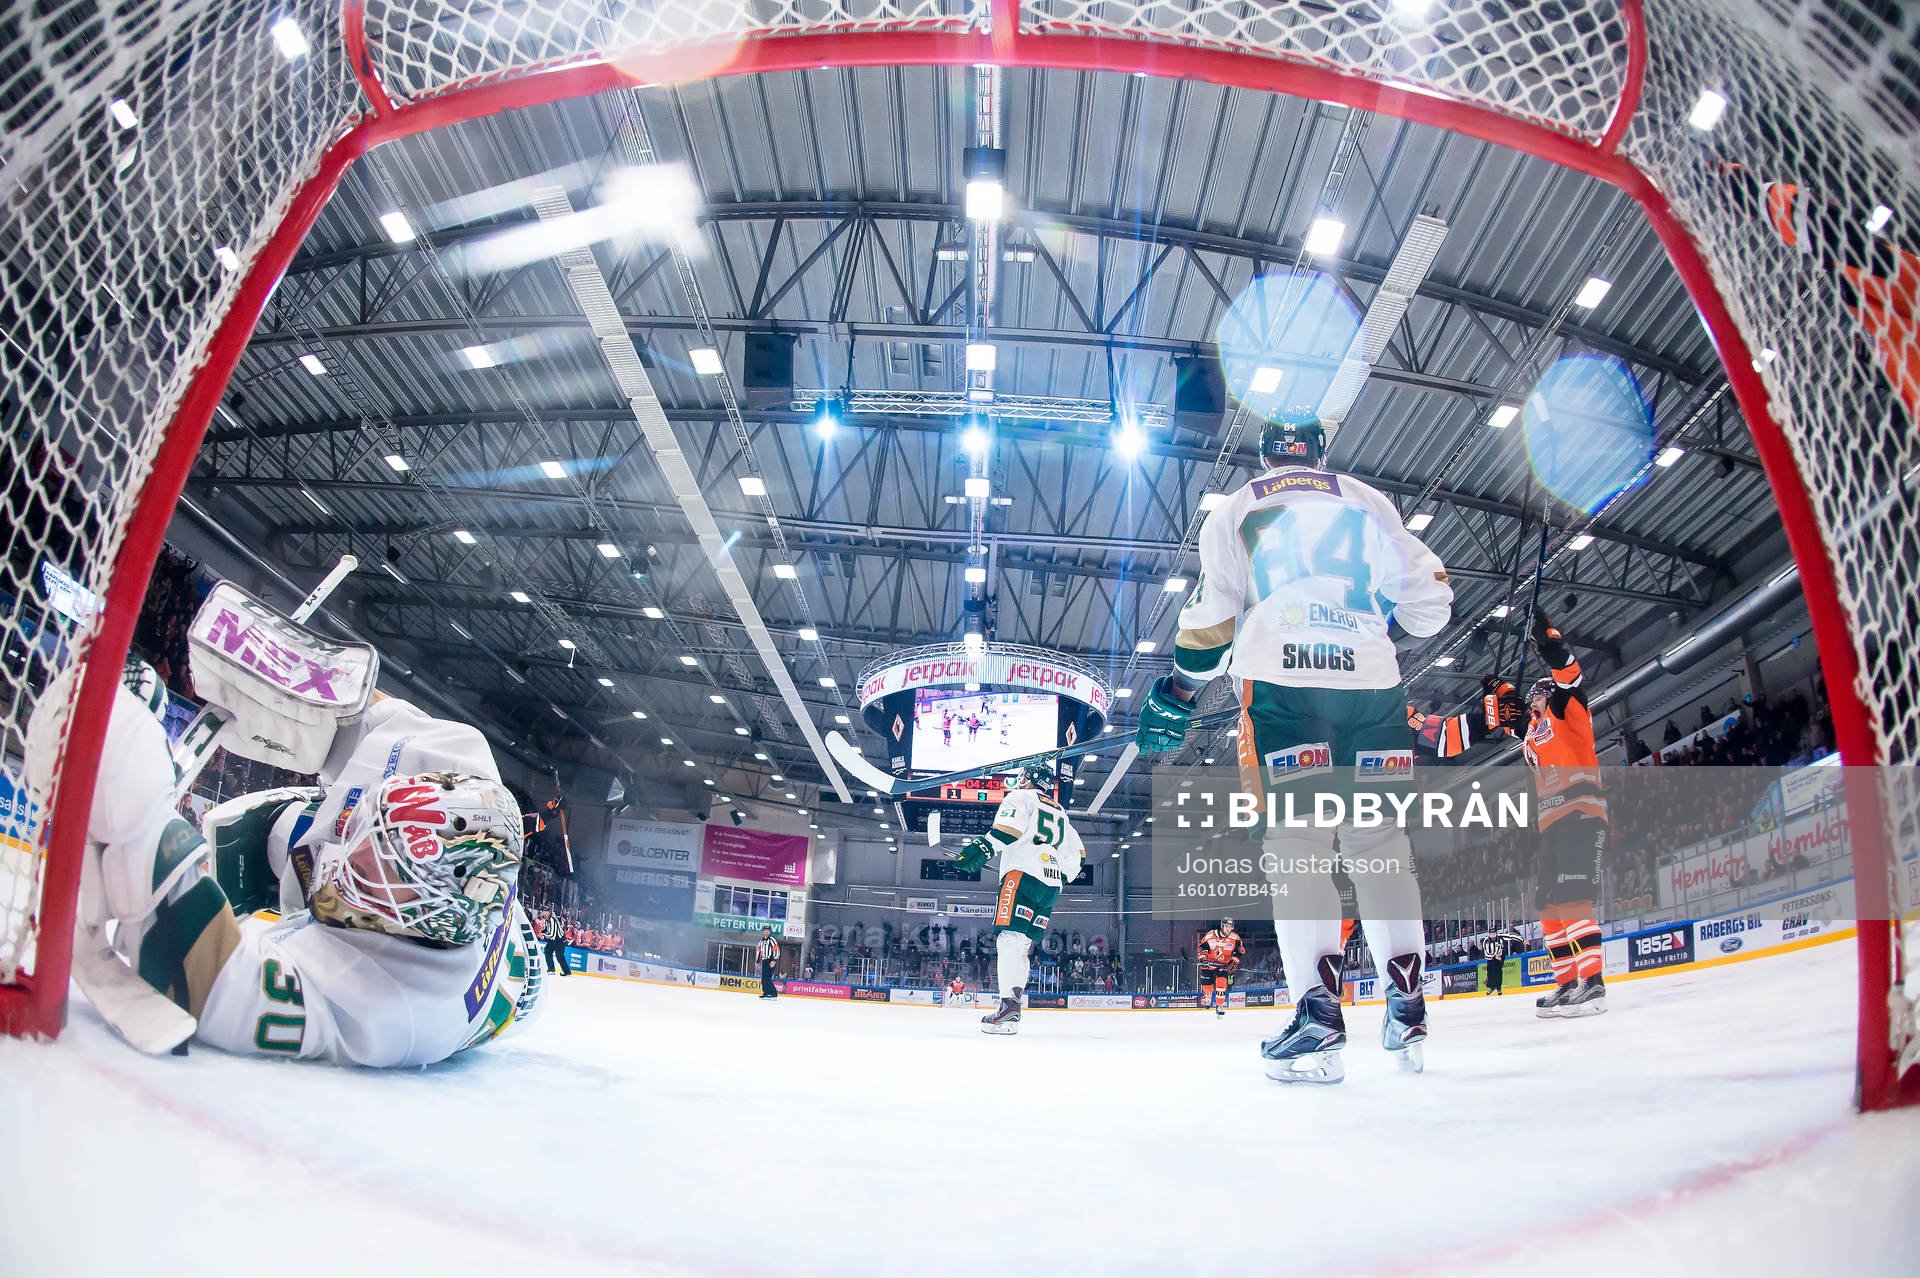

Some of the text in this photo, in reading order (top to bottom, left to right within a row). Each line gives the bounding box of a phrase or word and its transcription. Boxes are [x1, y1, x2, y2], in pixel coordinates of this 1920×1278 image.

[1283, 422, 1296, 432] 84
[1273, 441, 1307, 456] ELON
[1263, 477, 1332, 496] Löfbergs
[1310, 602, 1359, 630] ENERGI
[207, 608, 342, 701] MEX
[1282, 642, 1356, 671] SKOGS
[901, 659, 976, 689] jetpak
[1006, 661, 1079, 691] jetpak
[1273, 748, 1330, 777] ELON
[1359, 755, 1411, 776] ELON
[951, 790, 958, 798] 1
[966, 779, 1001, 790] 04:43
[978, 793, 986, 801] 3
[1000, 809, 1016, 818] 51
[1033, 808, 1066, 848] 51
[632, 846, 690, 861] BILCENTER
[974, 839, 992, 860] CCM
[1781, 890, 1832, 914] PETERSSONS
[713, 917, 746, 929] PETER
[1700, 911, 1763, 940] RÅBERGS BIL
[1782, 911, 1811, 931] GRÄV
[1636, 933, 1673, 956] 1852
[1635, 958, 1655, 968] MARIN
[1664, 951, 1689, 962] FRITID
[792, 985, 844, 995] printfabriken
[1359, 980, 1374, 996] BLT
[254, 957, 306, 1053] 30
